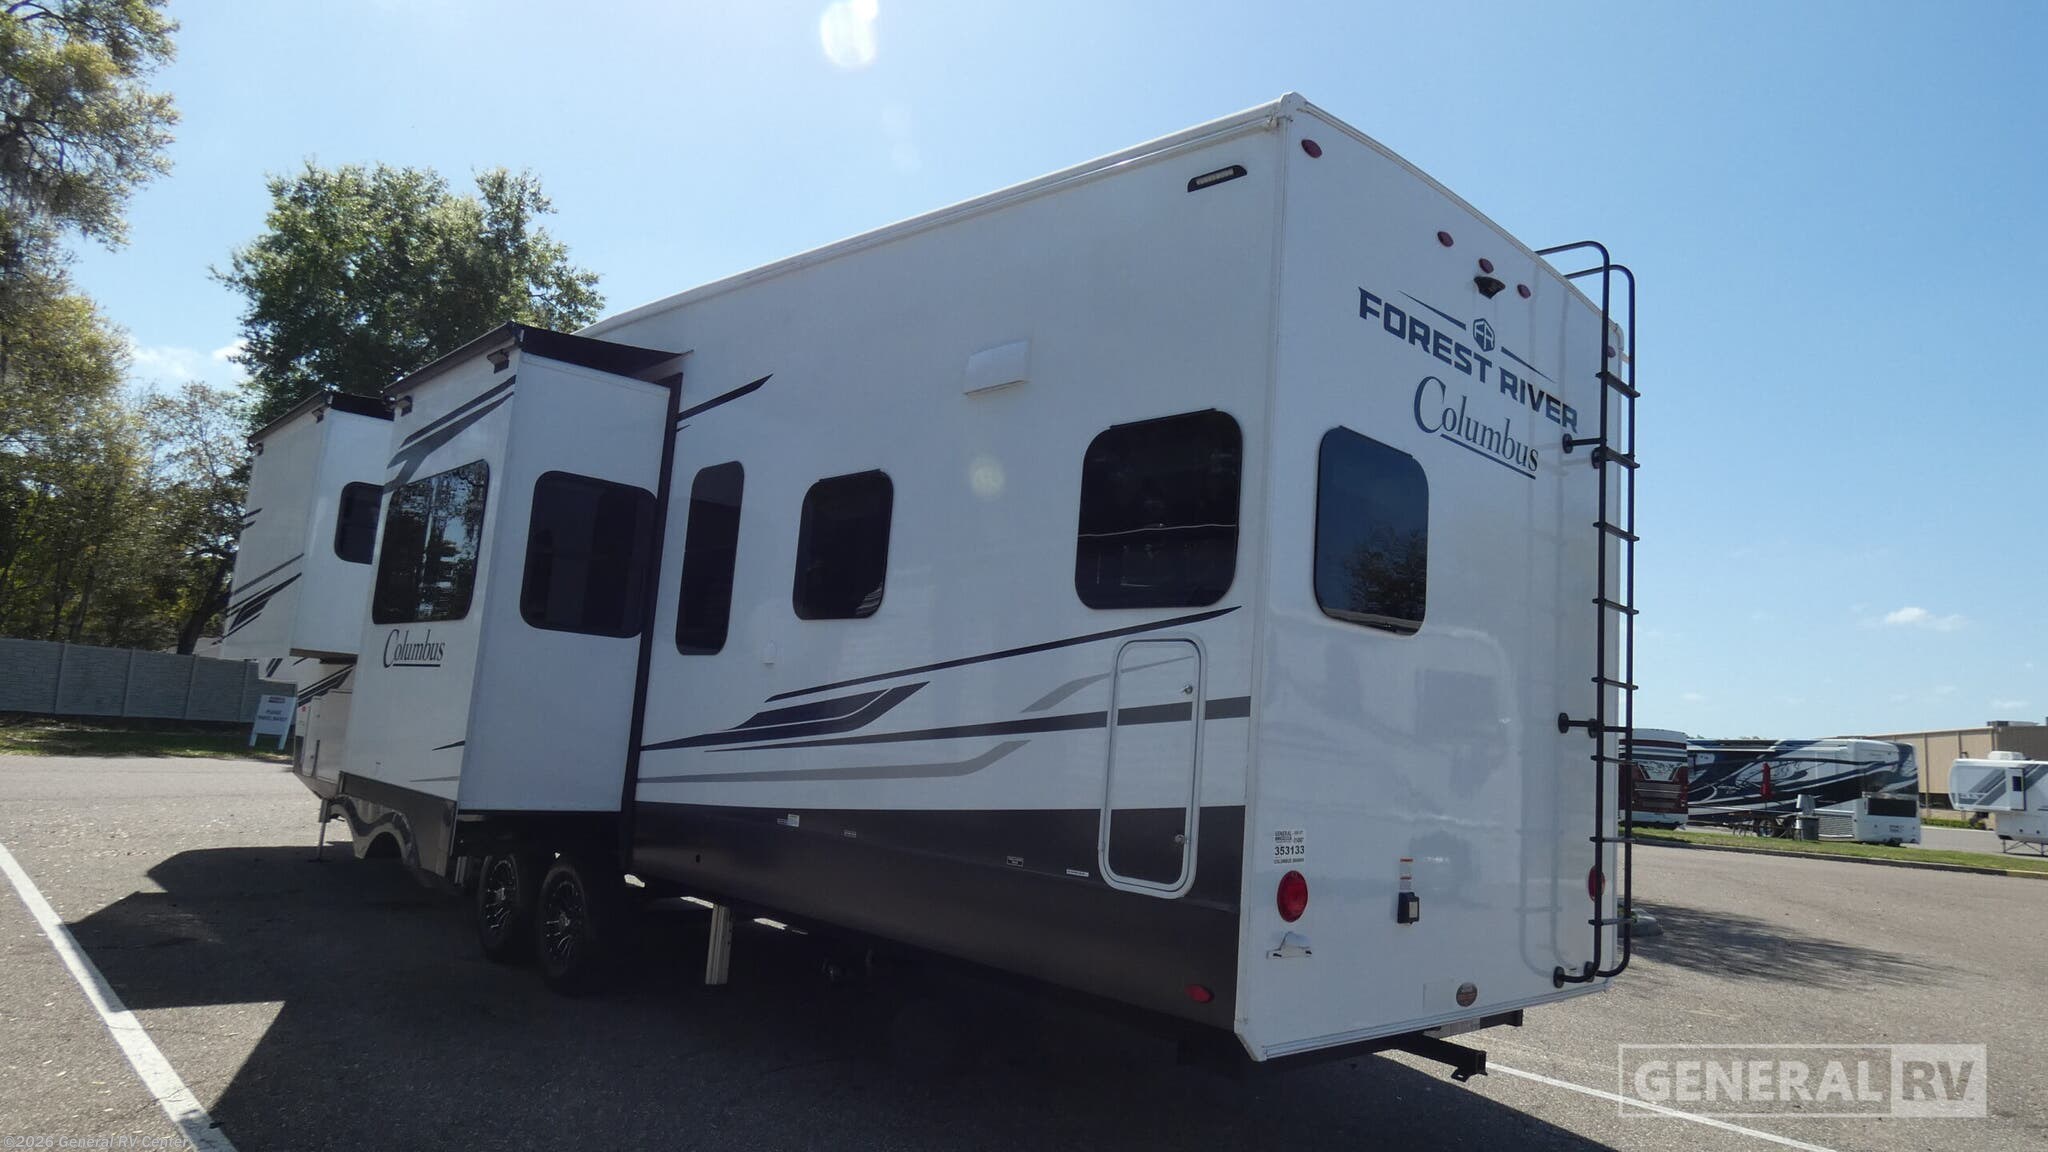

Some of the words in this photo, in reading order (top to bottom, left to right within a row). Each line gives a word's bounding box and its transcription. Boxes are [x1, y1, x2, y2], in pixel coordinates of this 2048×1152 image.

[1358, 286, 1493, 383] FOREST
[1499, 366, 1578, 433] RIVER
[1413, 375, 1539, 474] Columbus
[383, 628, 446, 668] Columbus
[1275, 846, 1304, 856] 353133
